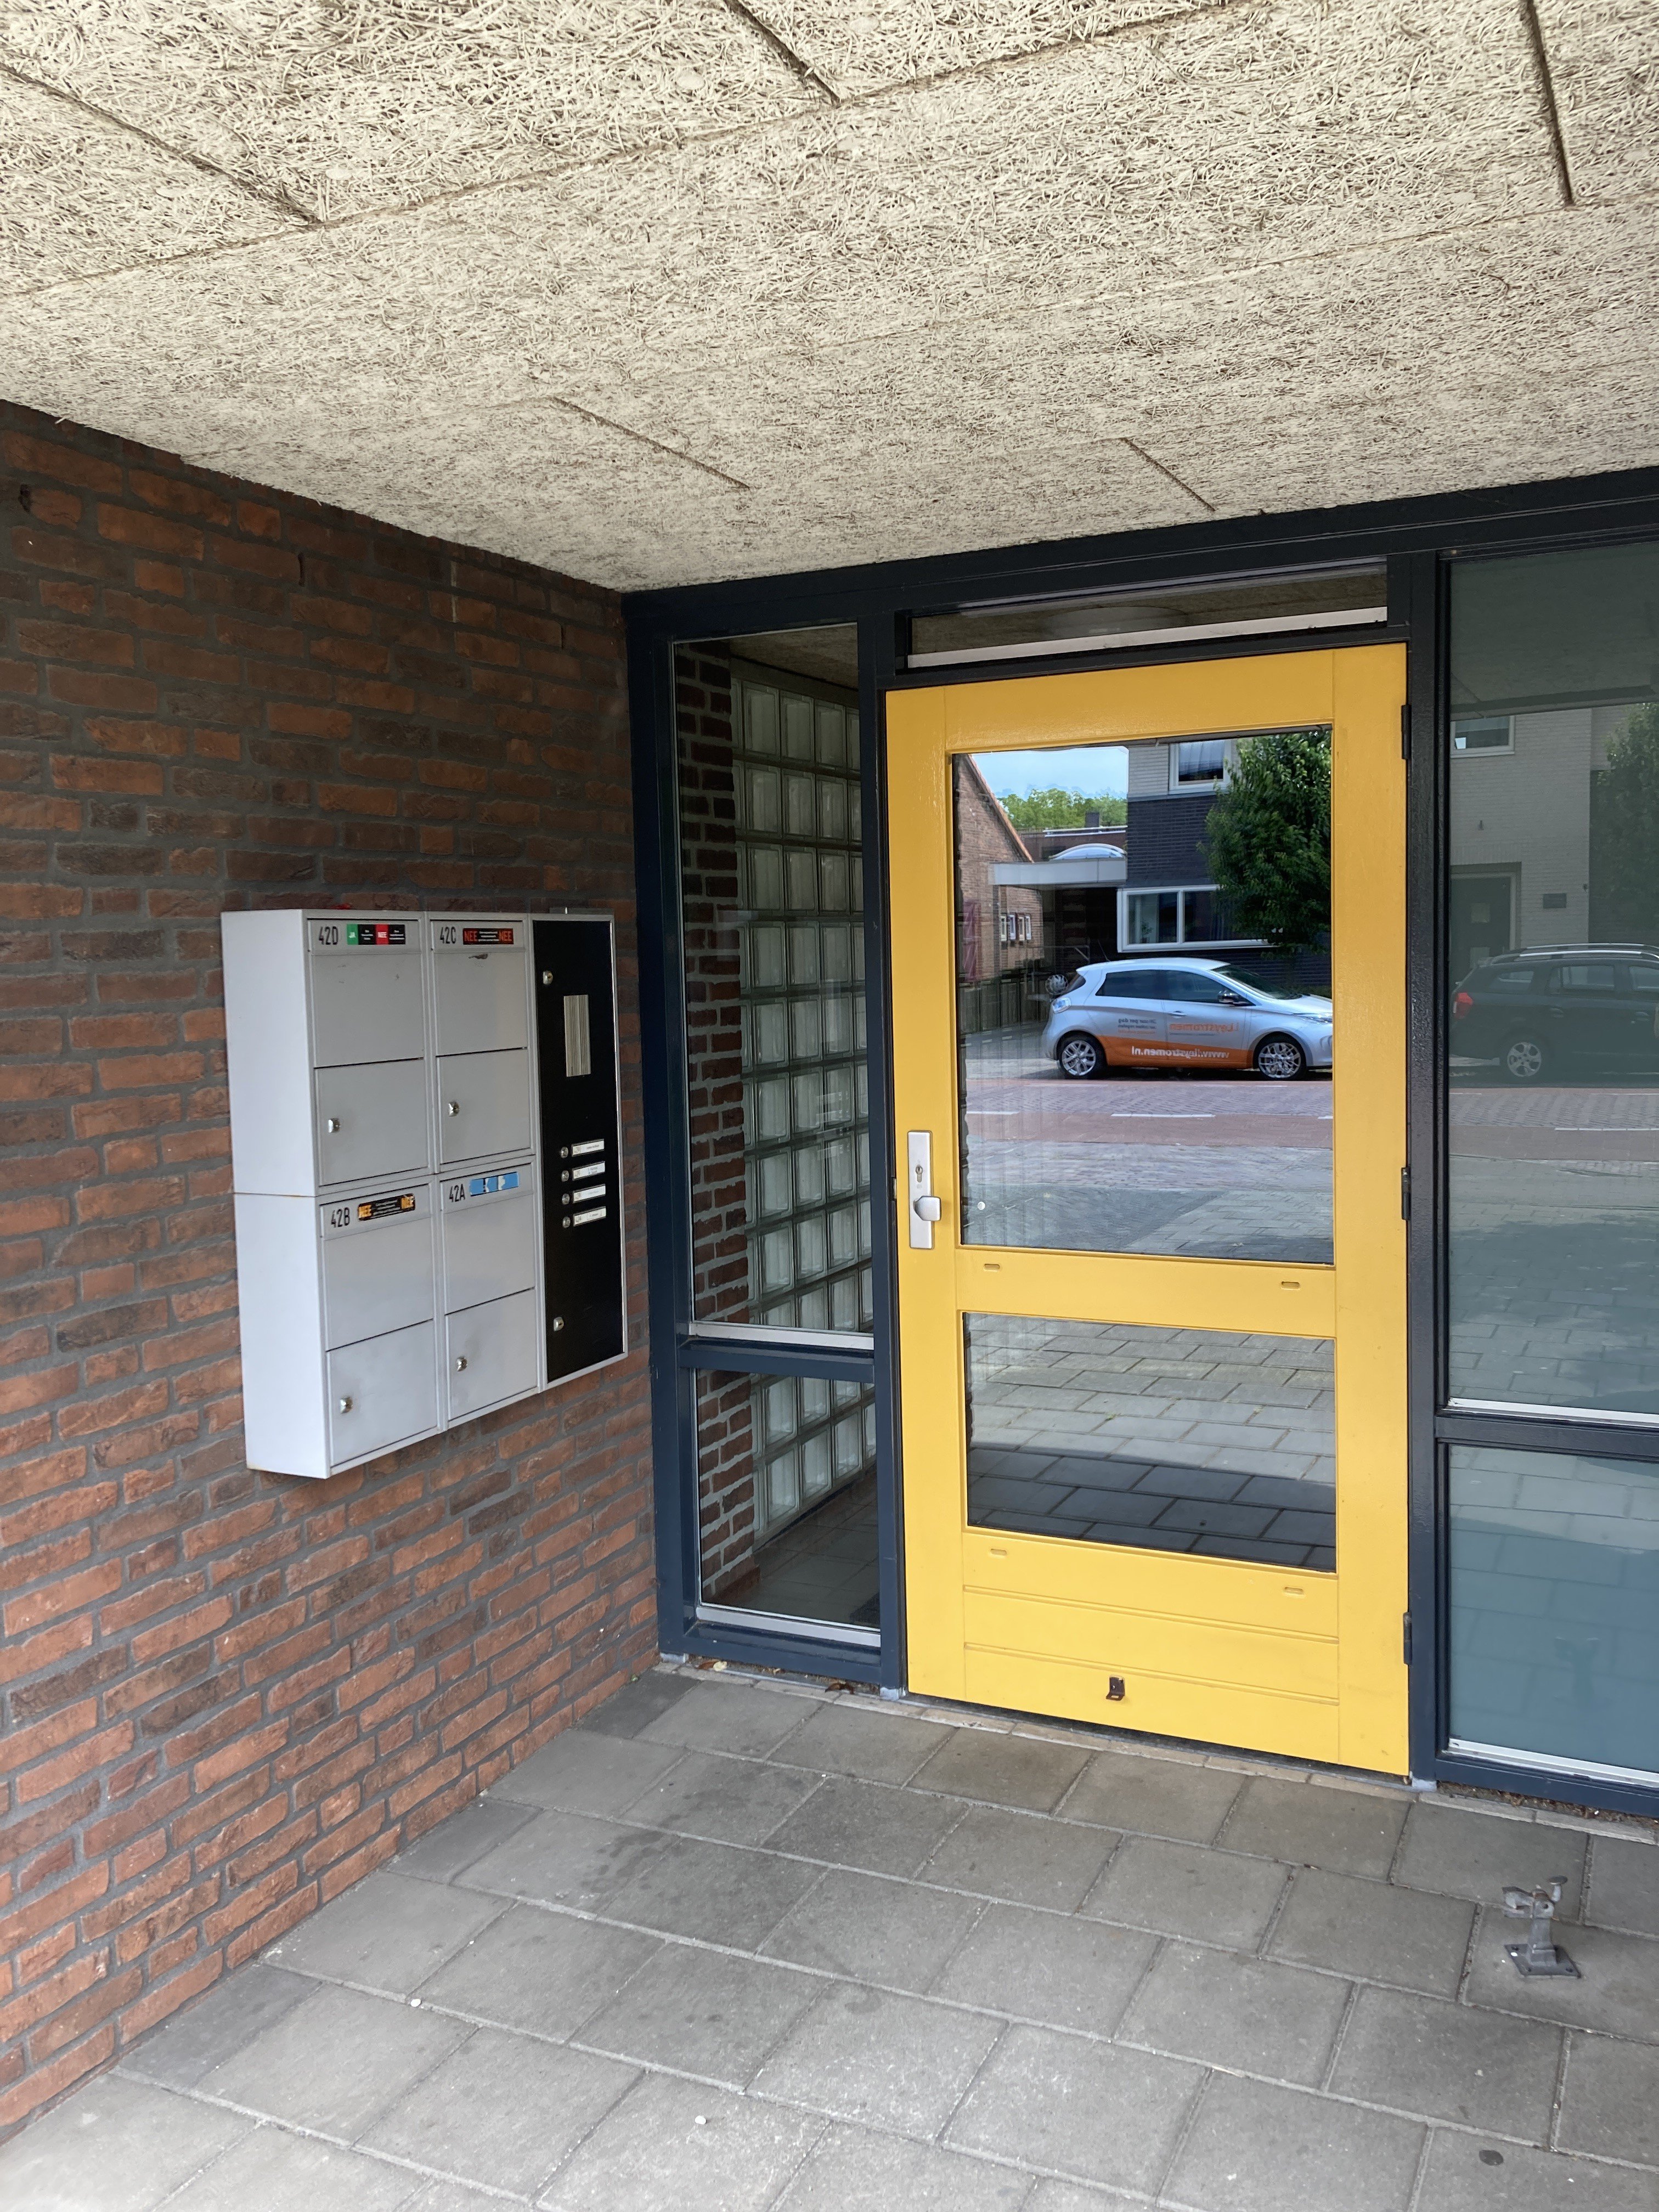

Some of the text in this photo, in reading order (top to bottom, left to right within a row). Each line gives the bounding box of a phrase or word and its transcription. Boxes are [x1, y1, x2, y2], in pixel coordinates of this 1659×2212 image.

[319, 926, 338, 945] 42D
[440, 926, 456, 944] 42C
[464, 930, 478, 942] NEE
[499, 930, 512, 942] NEE
[449, 1183, 466, 1203] 42A
[331, 1207, 351, 1228] 42B
